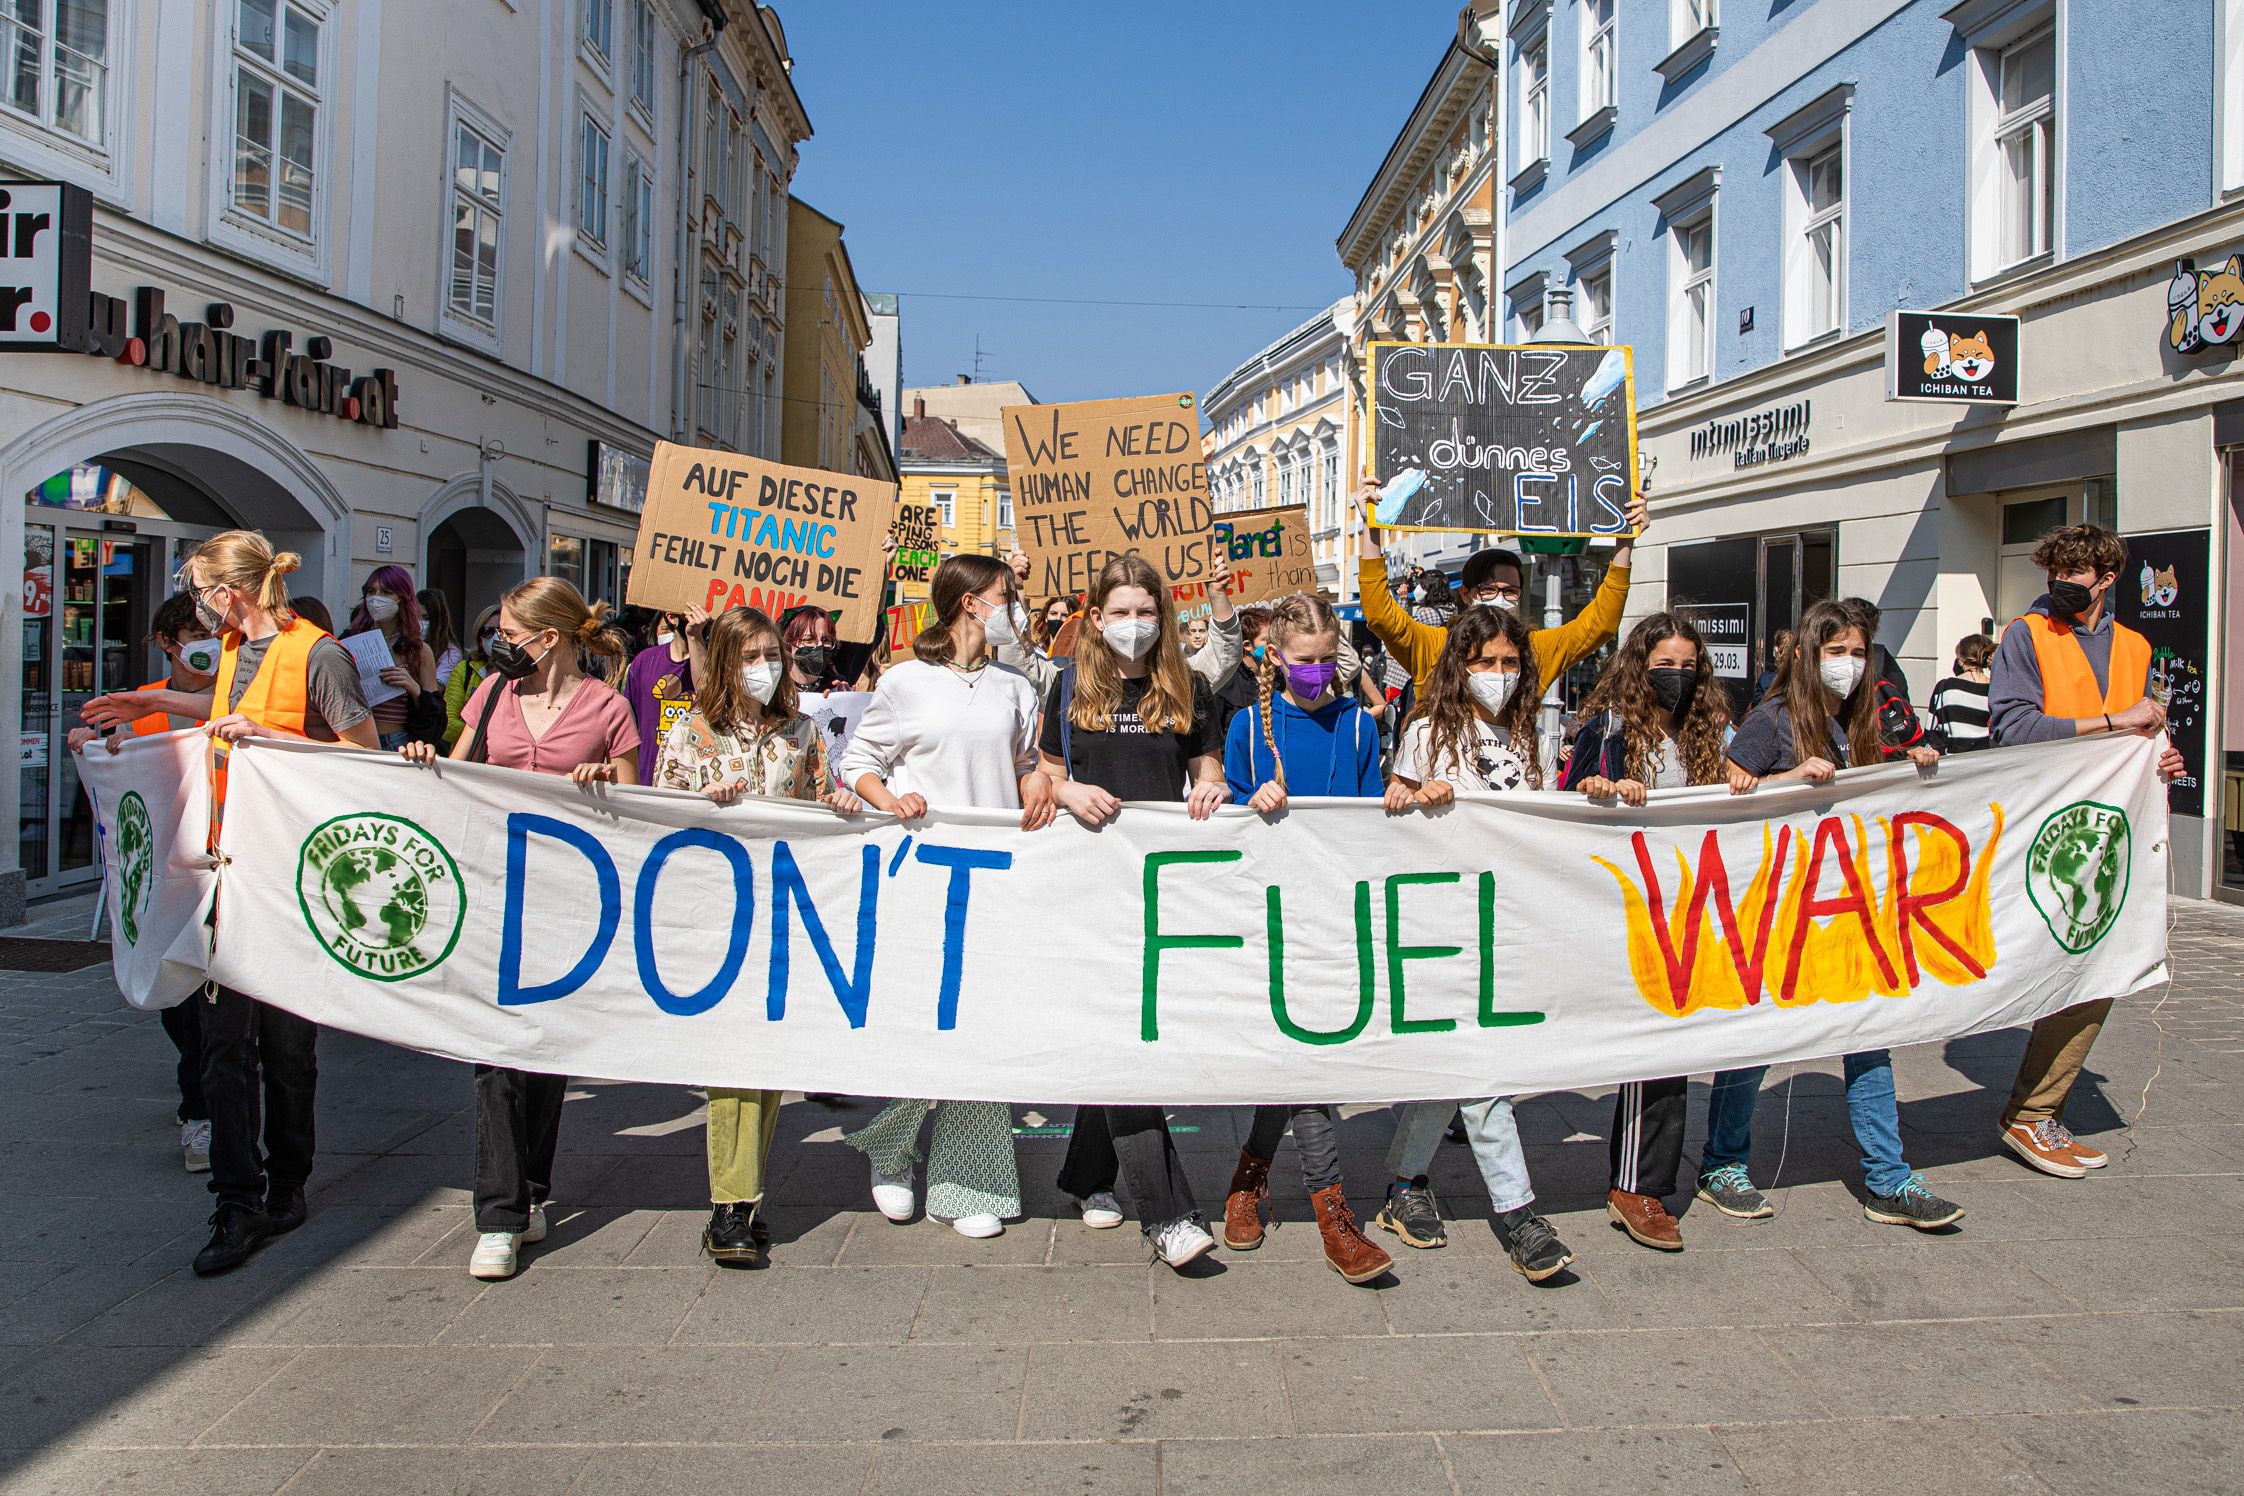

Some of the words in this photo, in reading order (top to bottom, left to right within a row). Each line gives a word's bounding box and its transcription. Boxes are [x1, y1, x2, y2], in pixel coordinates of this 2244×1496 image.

[1382, 347, 1568, 405] GANZ
[1920, 383, 1967, 395] ICHIBAN
[1972, 386, 1993, 396] TEA
[1105, 421, 1190, 457] NEED
[1429, 417, 1571, 473] dünnes
[1691, 399, 1811, 455] intimissimi
[1767, 435, 1810, 460] lingerie
[682, 463, 749, 500] AUF
[758, 475, 858, 522] DIESER
[1019, 471, 1091, 507] HUMAN
[1113, 462, 1208, 498] CHANGE,
[1514, 471, 1628, 534] EIS
[380, 529, 390, 545] 25
[708, 501, 837, 559] TITANIC
[900, 504, 938, 527] ARE
[1025, 510, 1091, 547] THE
[1113, 496, 1214, 541] WORLD
[893, 547, 938, 568] EACH
[1214, 517, 1285, 562] Planet
[1288, 526, 1307, 557] is
[650, 532, 727, 572] FEHLT
[733, 549, 810, 589] NOCH
[816, 563, 862, 599] DIE
[895, 565, 930, 583] ONE
[1044, 547, 1141, 597] NEE
[1165, 534, 1214, 581] US!
[1265, 560, 1312, 589] than
[2139, 610, 2166, 619] ICHIBAN
[2168, 610, 2180, 619] TEA
[1714, 652, 1740, 670] 29.03.
[306, 822, 399, 871] FRIDAYS
[402, 836, 445, 884] FOR
[498, 812, 1012, 1030] DON'T
[1141, 850, 1546, 1046] FUEL
[1631, 810, 1986, 1010] WAR
[331, 934, 428, 973] FUTURE
